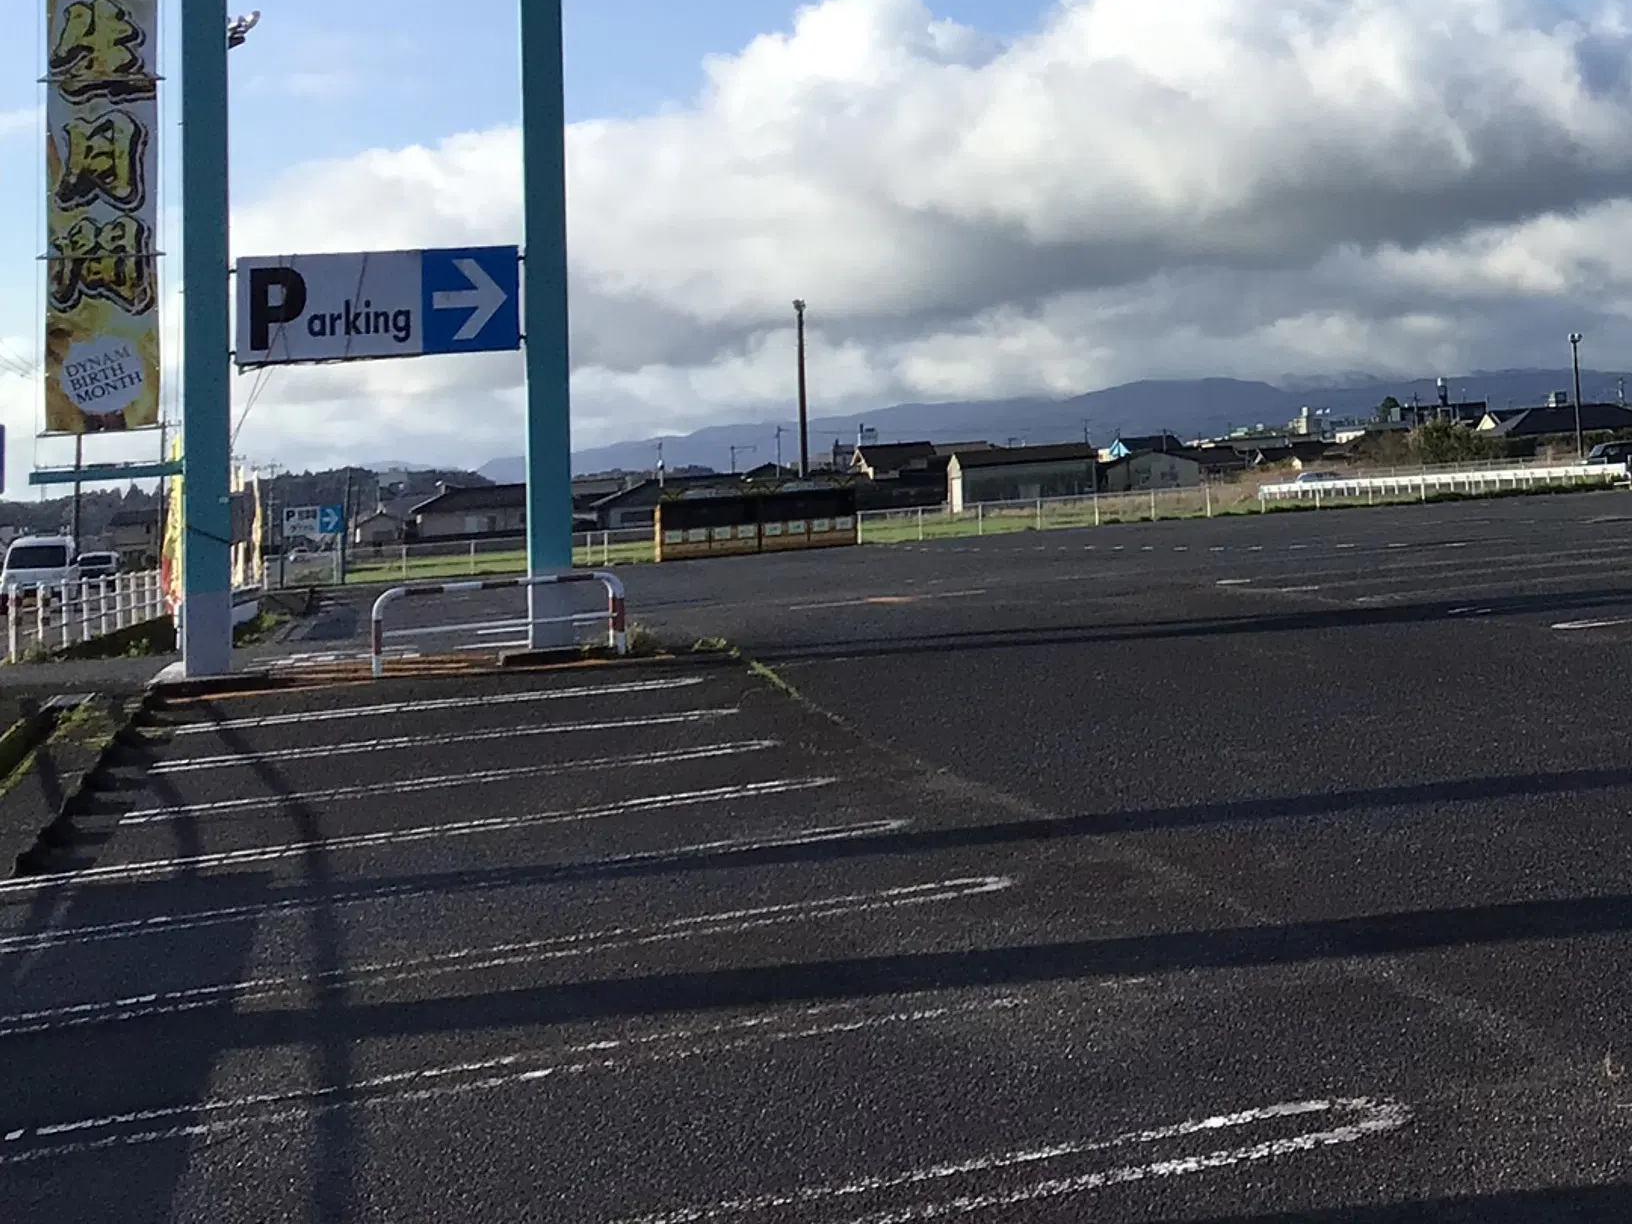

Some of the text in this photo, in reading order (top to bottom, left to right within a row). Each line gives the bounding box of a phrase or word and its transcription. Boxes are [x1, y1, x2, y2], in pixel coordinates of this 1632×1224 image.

[250, 267, 411, 351] Parking
[65, 345, 131, 378] DYNAM
[70, 363, 125, 391] BIRTH
[75, 371, 142, 404] MONTH
[286, 510, 296, 522] P
